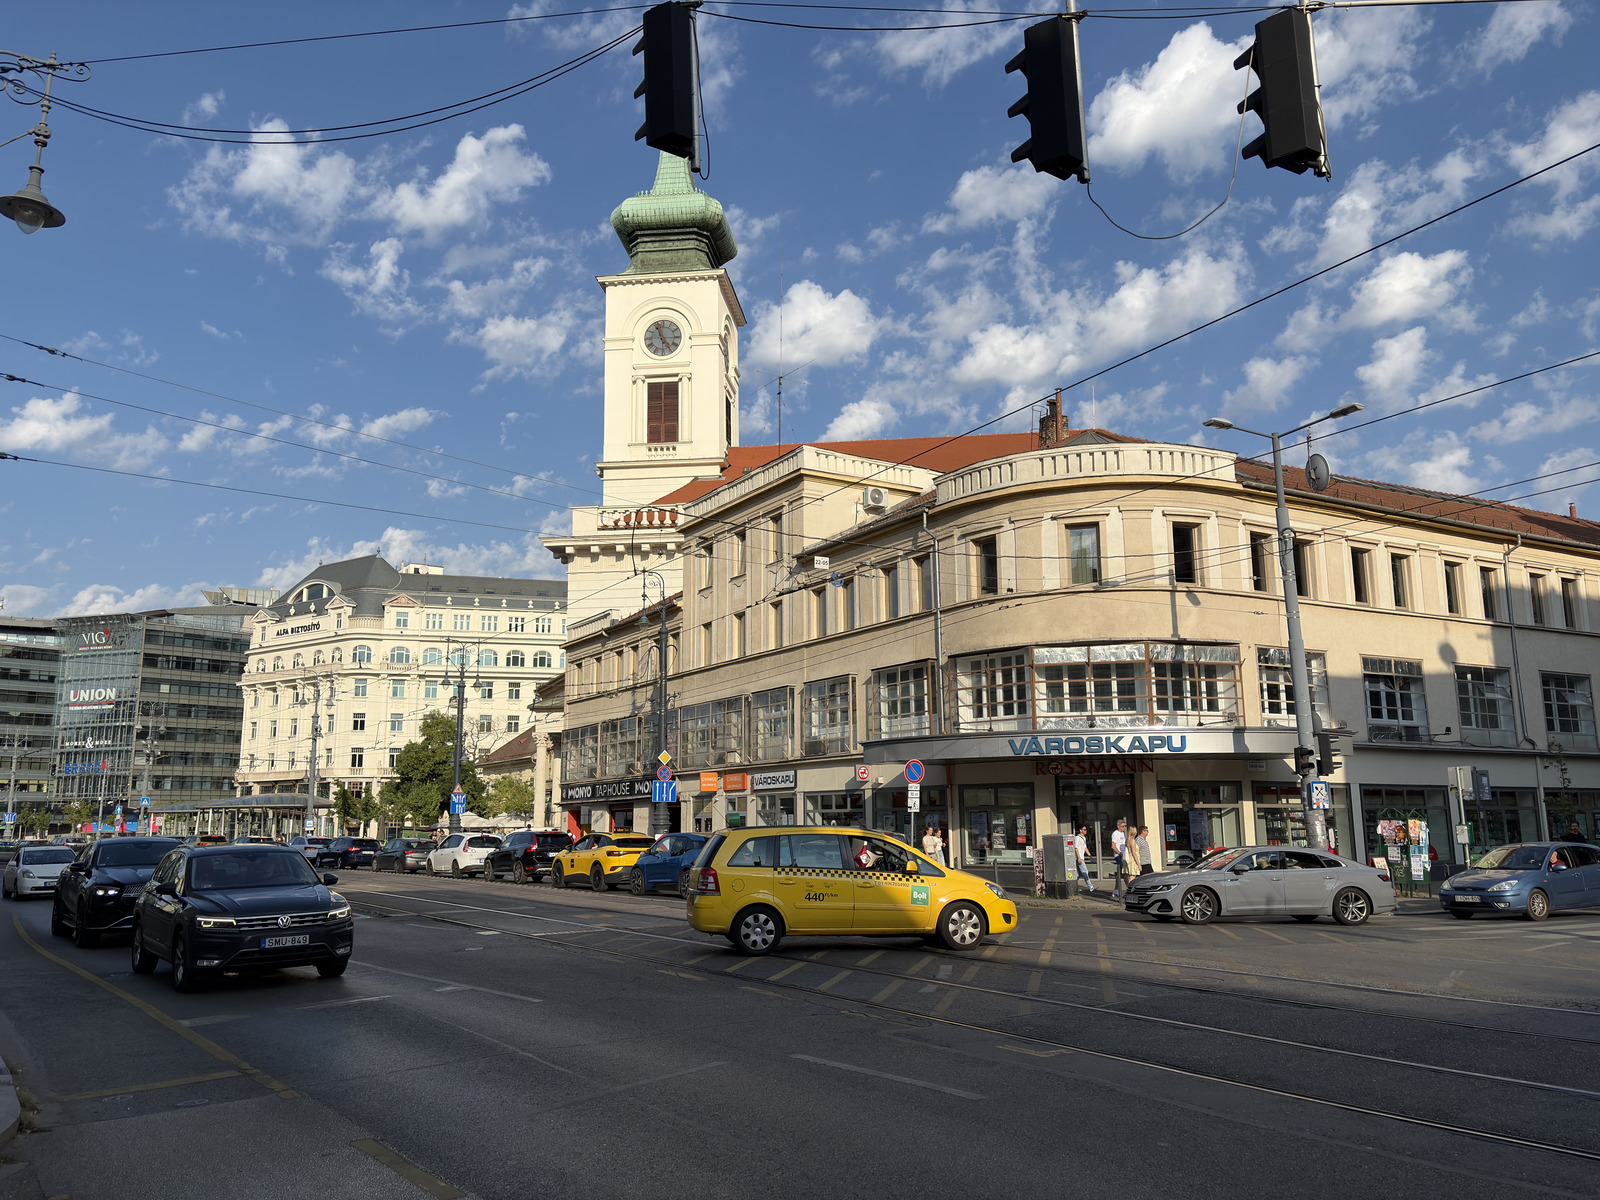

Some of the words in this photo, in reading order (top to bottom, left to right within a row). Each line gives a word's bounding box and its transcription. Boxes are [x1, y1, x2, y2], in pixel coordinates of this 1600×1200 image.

[276, 628, 289, 637] ALFA
[290, 621, 321, 635] BIZTOSÍTÓ
[82, 631, 106, 645] VIG
[69, 687, 116, 702] UNION
[85, 736, 94, 749] &
[1008, 735, 1187, 756] VÁROSKAPU
[64, 762, 101, 775] ERSTE
[1035, 758, 1155, 776] ROSSMANN
[754, 774, 794, 787] VÁROSKAPU
[567, 786, 592, 799] MONYO
[596, 782, 630, 797] TAPHOUSE
[804, 892, 825, 902] 440
[913, 891, 927, 900] Bolt
[267, 935, 308, 947] SMU-849
